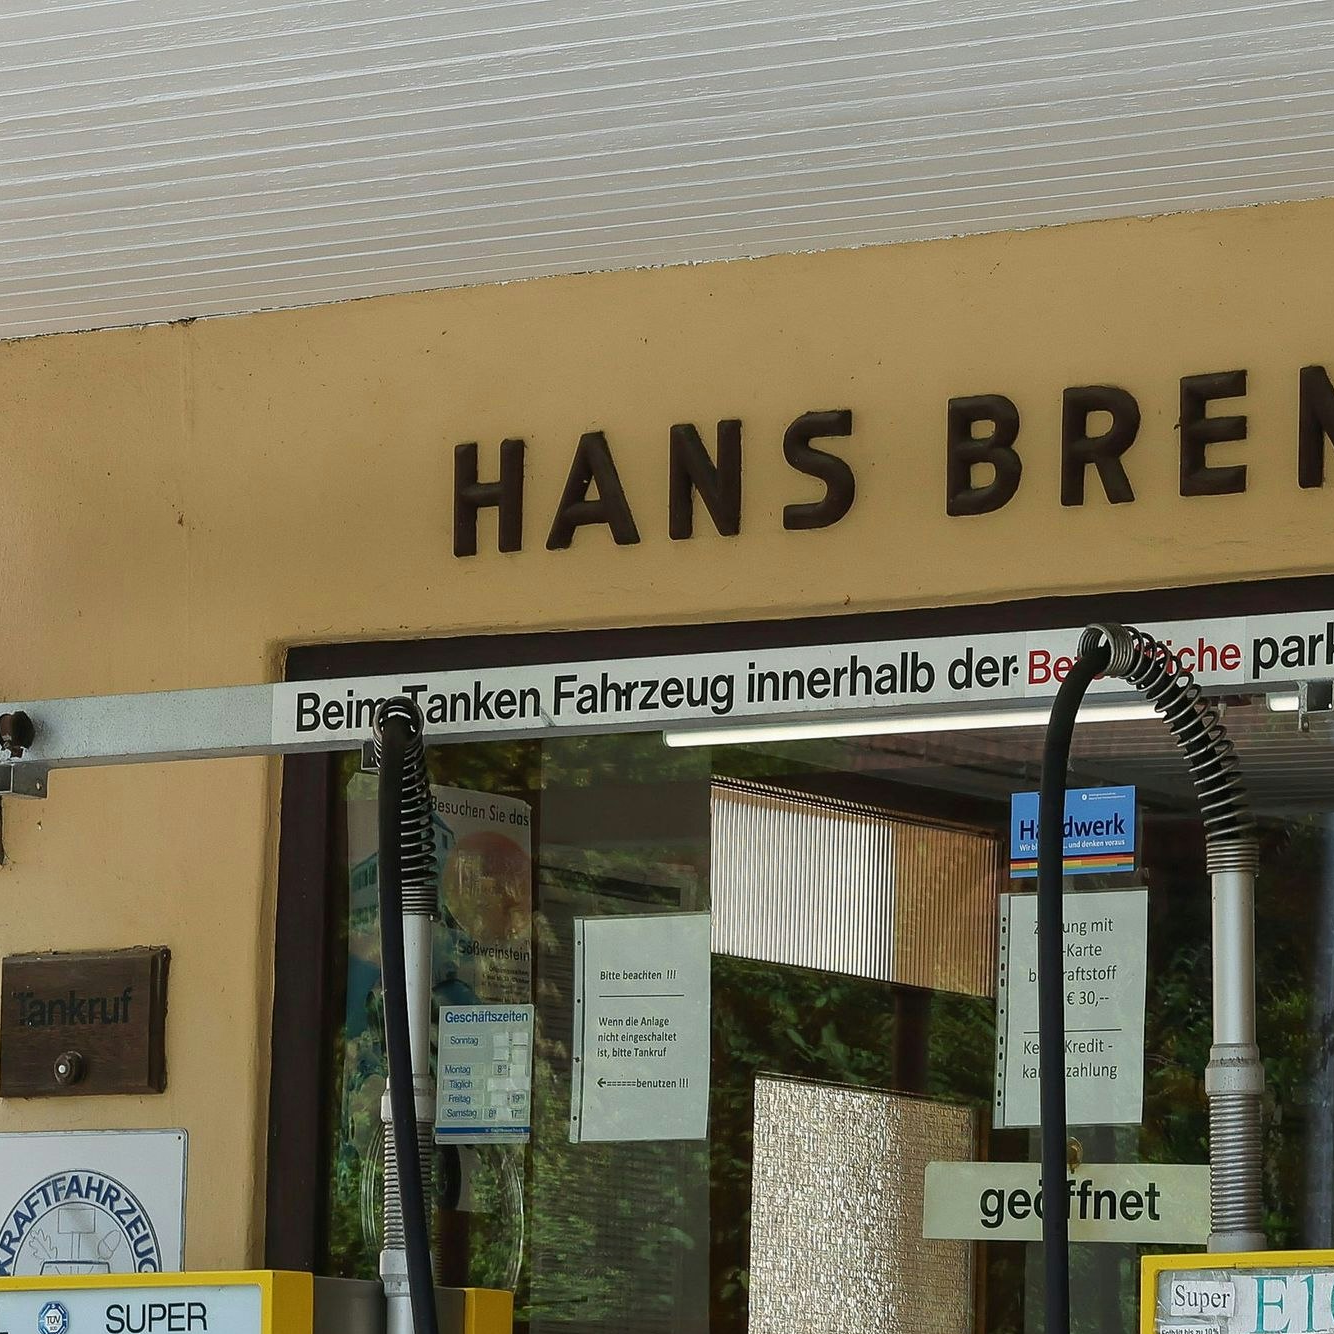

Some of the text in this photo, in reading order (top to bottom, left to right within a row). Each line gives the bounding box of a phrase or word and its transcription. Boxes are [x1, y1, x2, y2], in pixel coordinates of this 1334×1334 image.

[454, 407, 857, 558] HANS
[296, 689, 388, 732] Beim
[402, 681, 541, 725] Tanken
[553, 672, 734, 715] Fahrzeug
[747, 651, 934, 703] innerhalb
[948, 647, 1017, 690] der
[431, 795, 529, 826] Besuchen Sie das
[1020, 813, 1125, 841] Hdwerk
[1019, 843, 1031, 851] Wir
[1069, 840, 1080, 848] und
[1081, 838, 1104, 847] denken
[1105, 839, 1125, 847] voraus
[1034, 918, 1113, 936] Zung mit
[600, 970, 677, 980] Bitte beachten !!!
[1064, 965, 1117, 981] raftstoff
[1067, 991, 1075, 1005] €
[11, 986, 133, 1027] Tankruf
[445, 1011, 529, 1024] Geschäftszeiten
[598, 1016, 670, 1028] Wenn die Anlage
[450, 1035, 479, 1046] Sonntag
[597, 1031, 677, 1044] nicht eingeschaltet
[1065, 1038, 1105, 1053] Kredit
[597, 1047, 667, 1059] ist, bitte Tankruf
[445, 1064, 471, 1075] Montag
[679, 1078, 689, 1089] !!!
[448, 1094, 471, 1104] Freitag
[447, 1108, 477, 1118] Samstag
[1174, 1284, 1231, 1315] Super
[106, 1302, 208, 1334] SUPER
